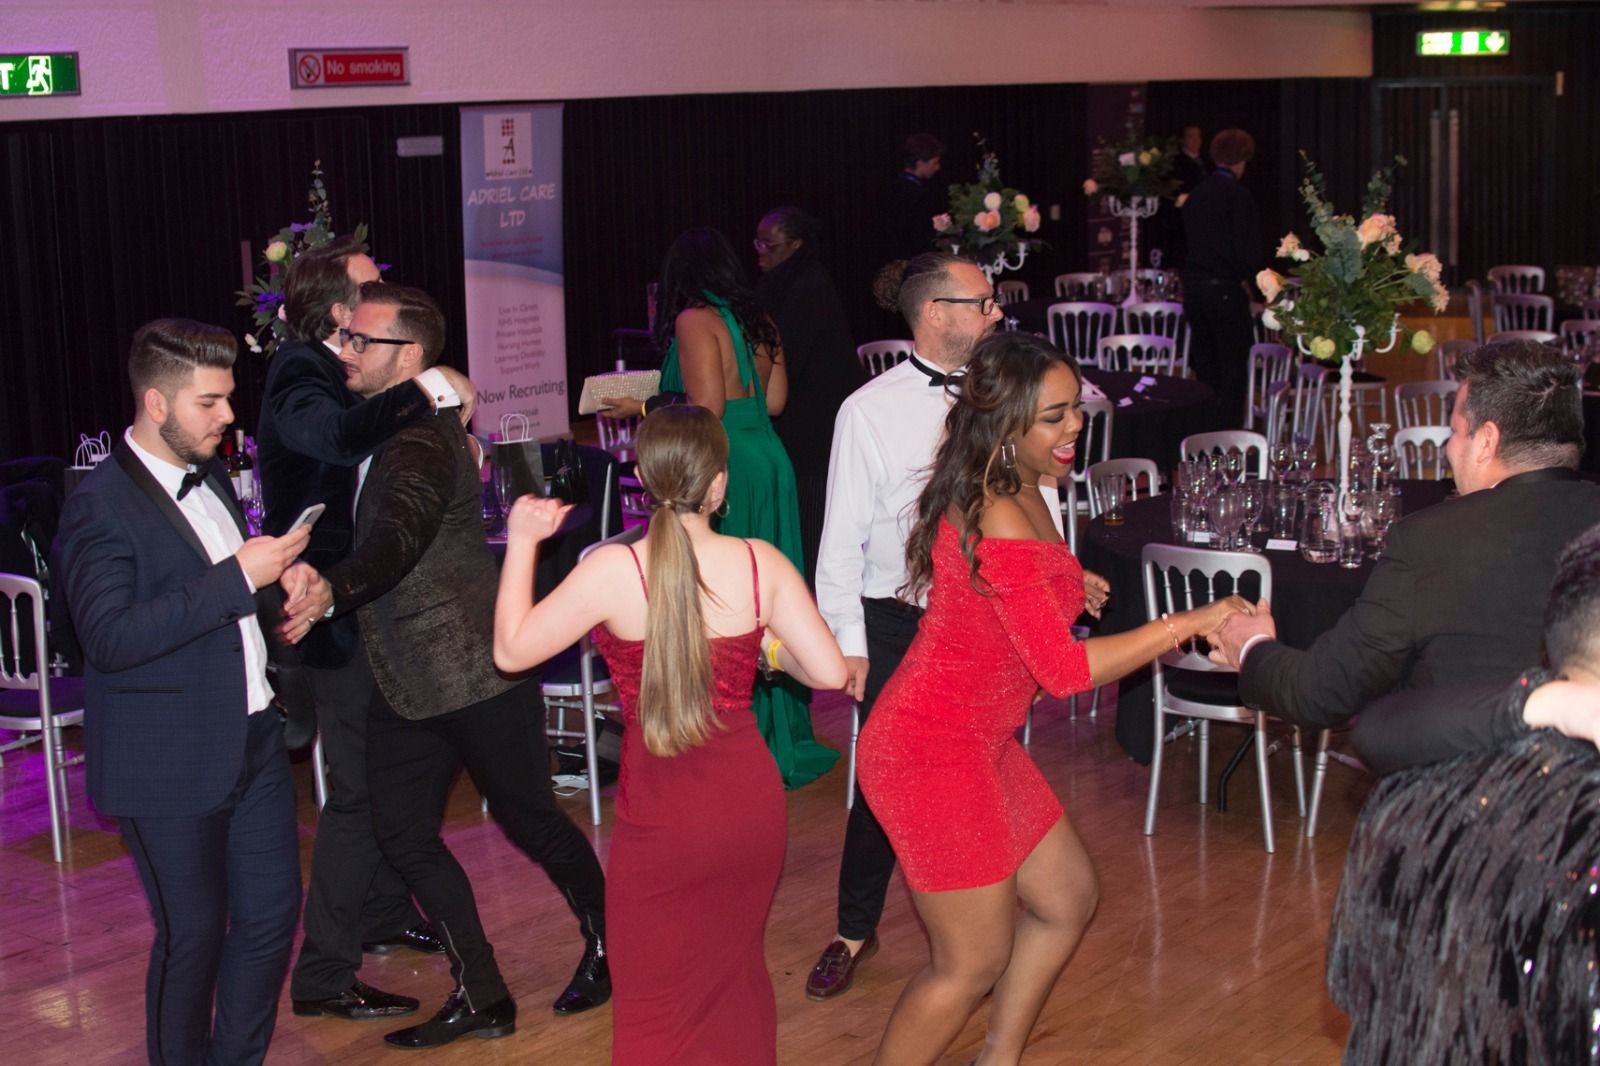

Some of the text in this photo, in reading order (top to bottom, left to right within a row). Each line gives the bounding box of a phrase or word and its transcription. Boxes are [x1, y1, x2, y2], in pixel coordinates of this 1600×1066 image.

[327, 59, 400, 76] No smoking
[467, 183, 556, 206] ADRIEL CARE
[500, 210, 526, 228] LTD
[476, 381, 565, 405] Now Recruiting
